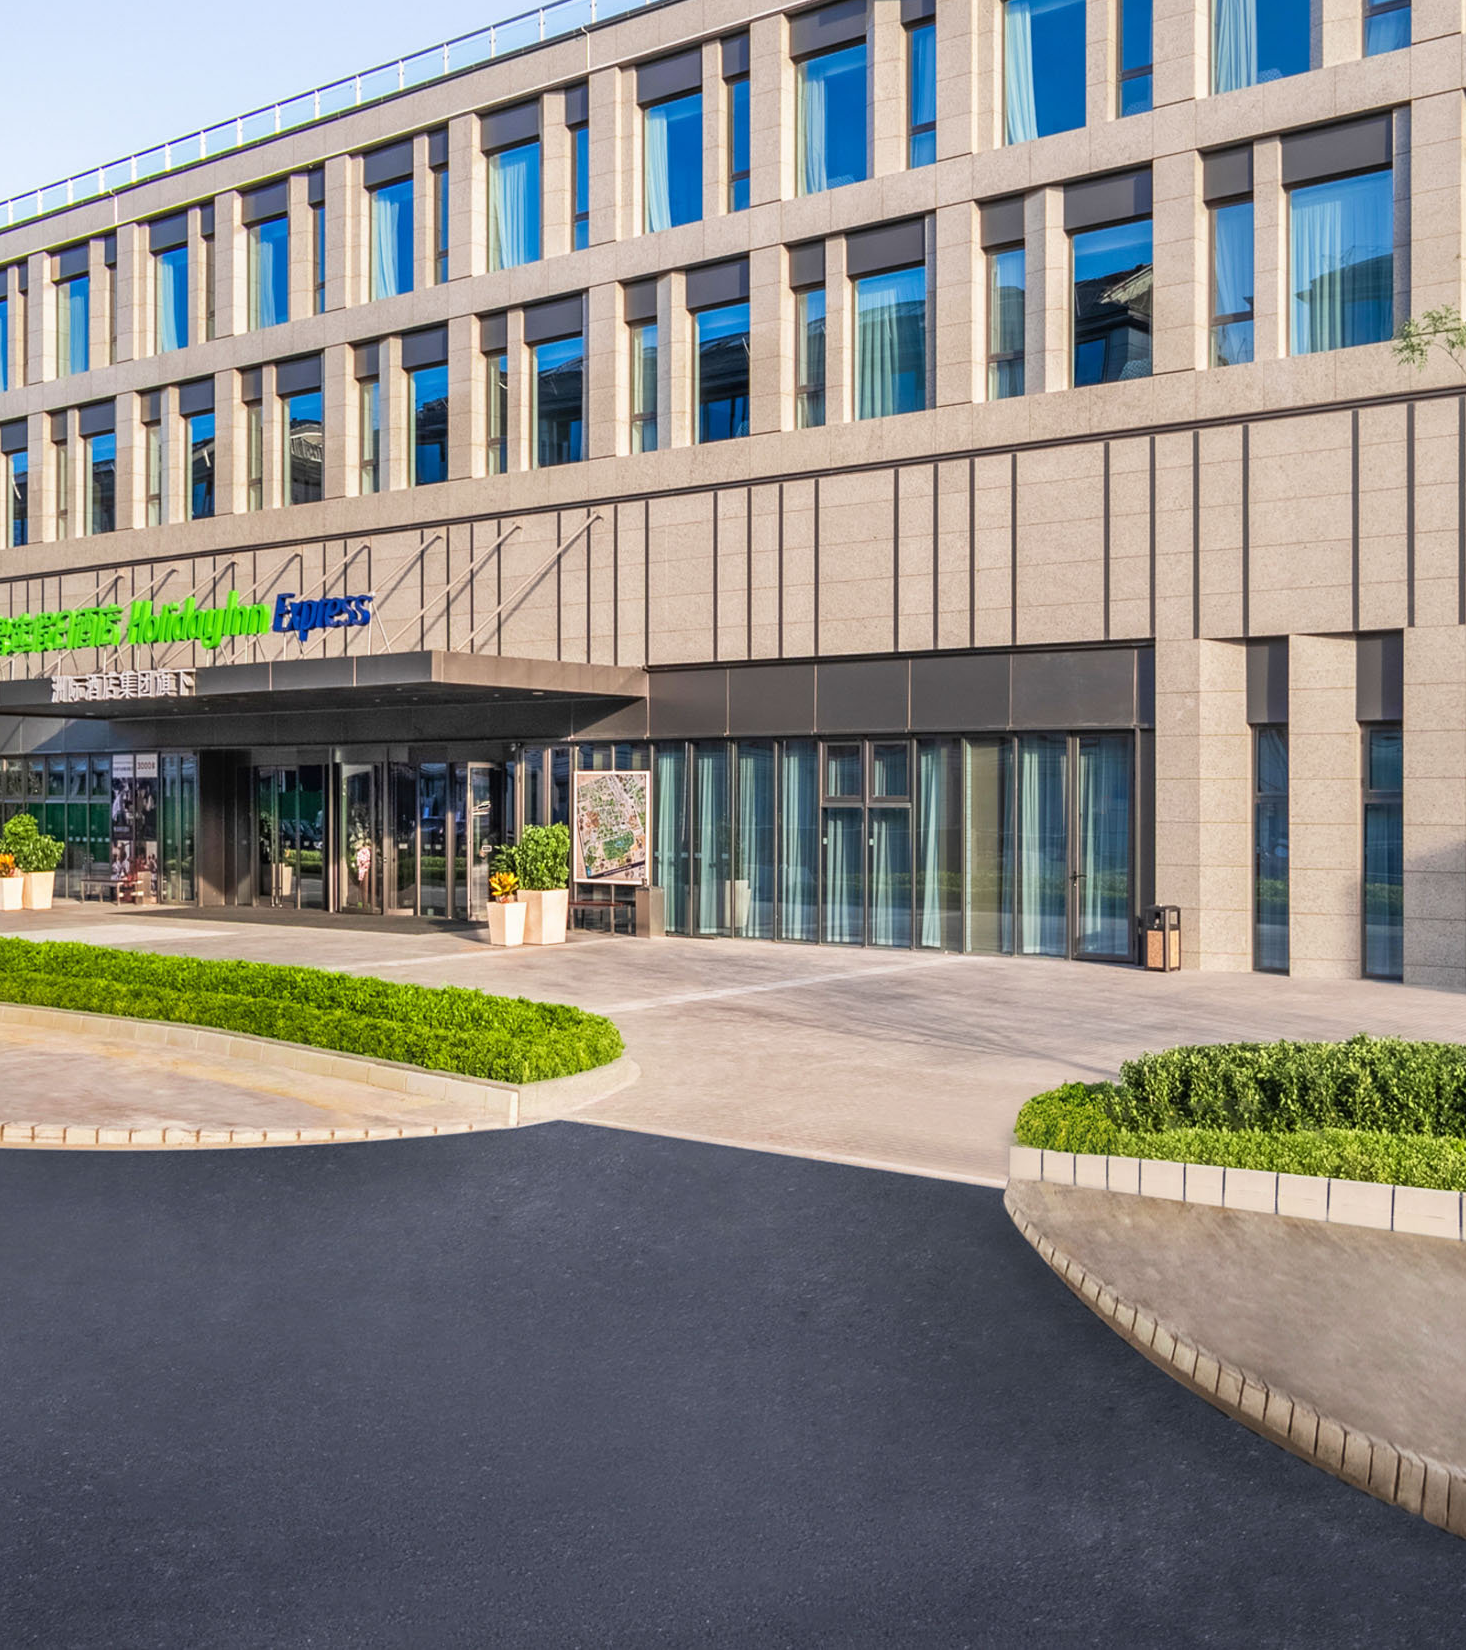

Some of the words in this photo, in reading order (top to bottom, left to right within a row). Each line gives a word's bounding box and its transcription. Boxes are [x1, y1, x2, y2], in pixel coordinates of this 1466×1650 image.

[127, 596, 223, 649] Holiday
[221, 590, 271, 636] Inn
[273, 593, 373, 642] Express
[51, 668, 196, 703] 洲际酒店集团旗下
